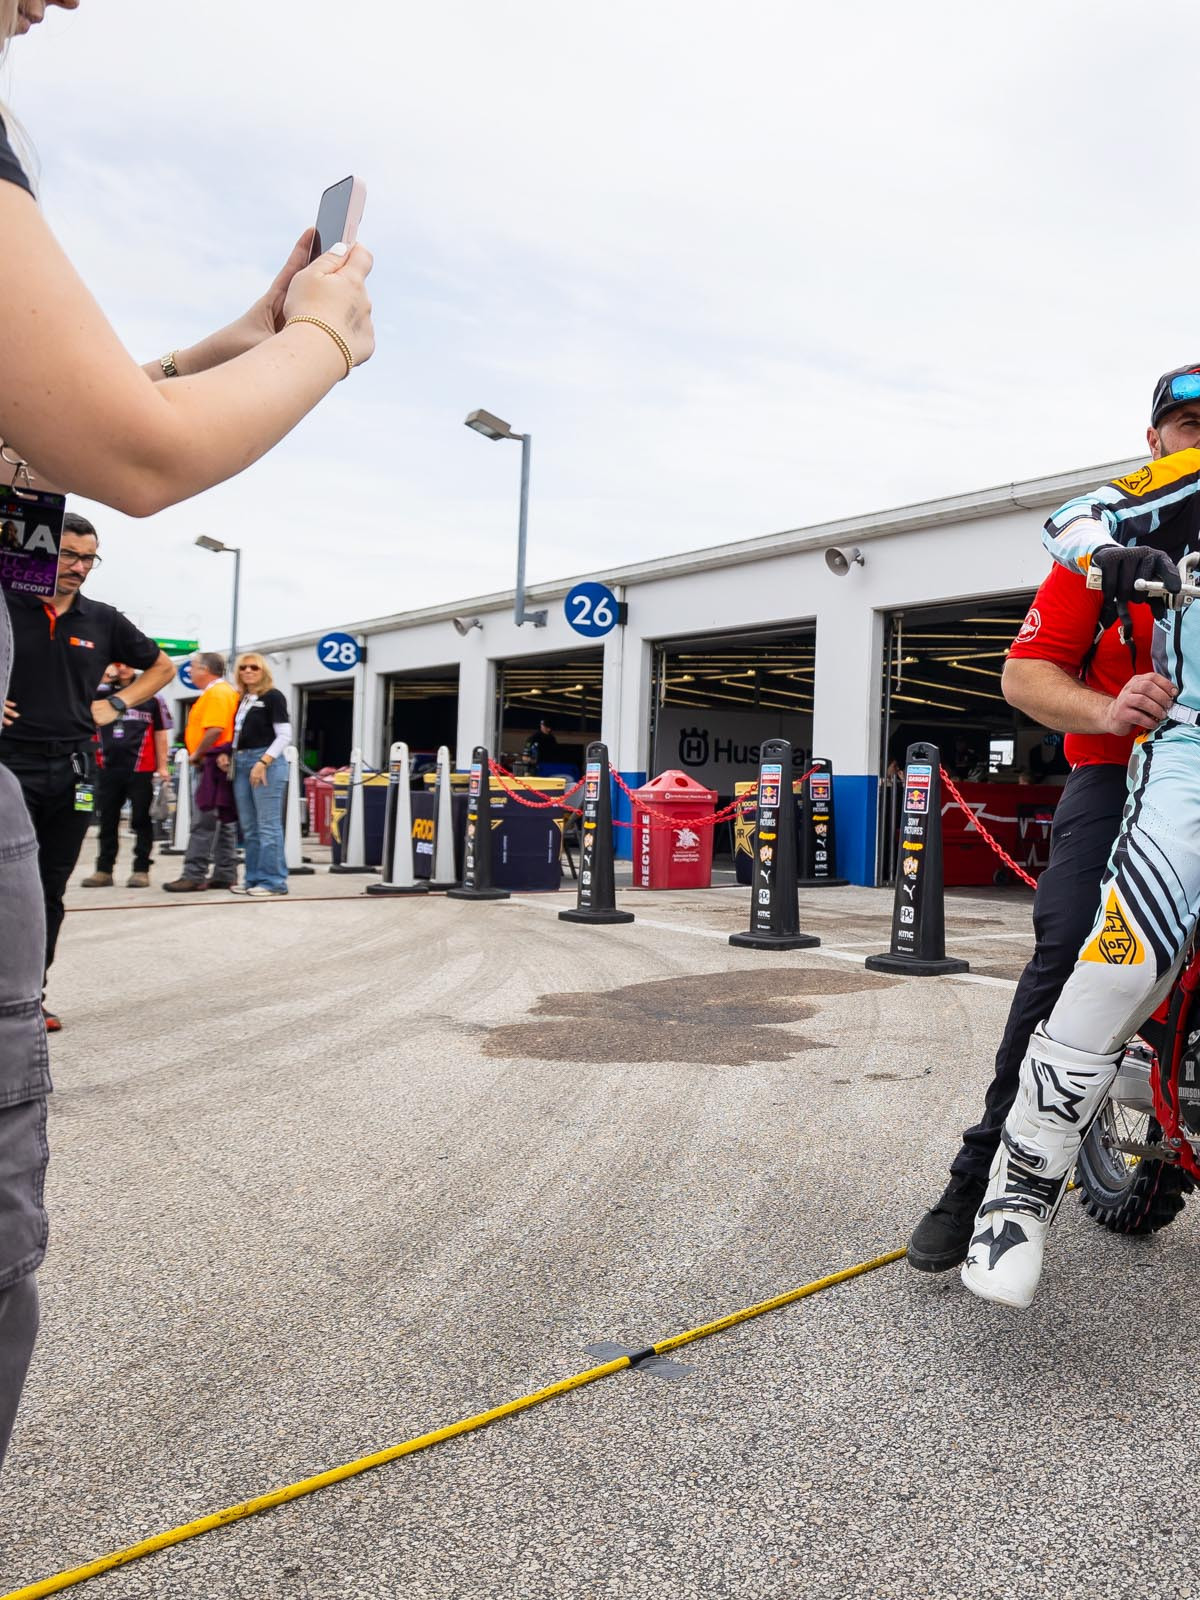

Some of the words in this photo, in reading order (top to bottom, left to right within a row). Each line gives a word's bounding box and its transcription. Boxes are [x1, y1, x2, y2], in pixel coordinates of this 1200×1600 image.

[11, 580, 51, 595] ESCORT
[571, 595, 614, 627] 26
[322, 640, 357, 664] 28
[904, 826, 924, 836] PICTURES
[908, 817, 920, 826] SONY
[641, 814, 651, 887] RECYCLE
